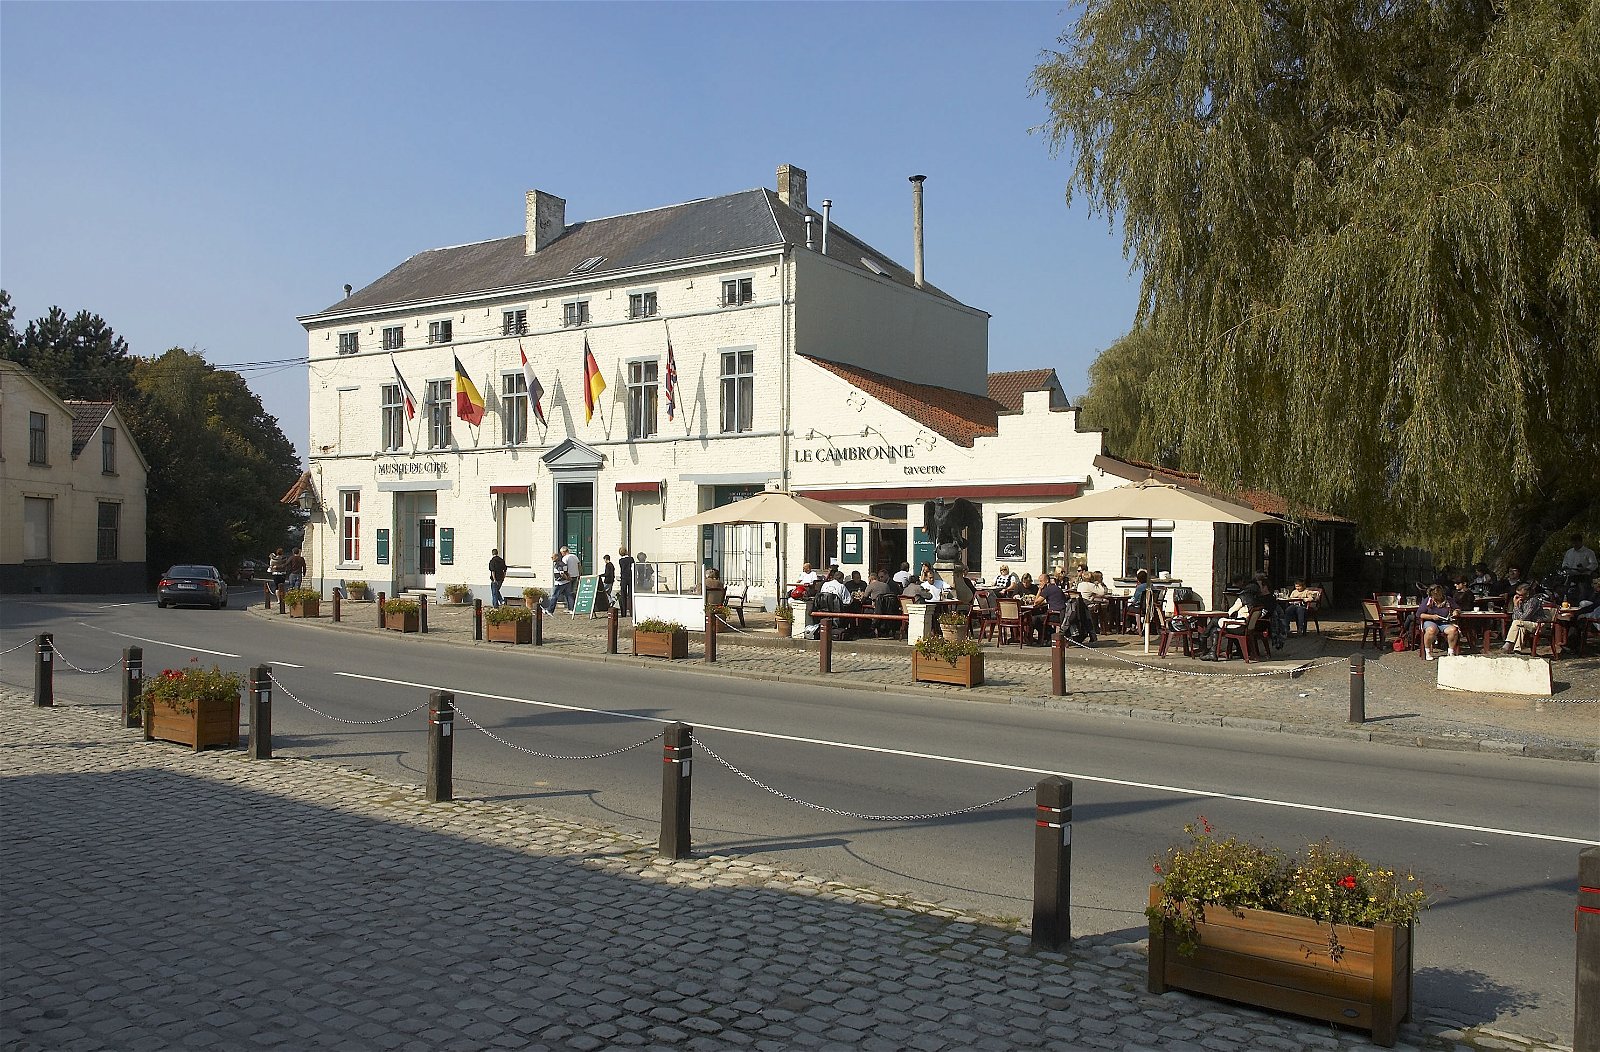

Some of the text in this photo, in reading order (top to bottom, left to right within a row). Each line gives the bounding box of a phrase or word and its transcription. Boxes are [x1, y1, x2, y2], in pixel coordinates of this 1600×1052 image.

[795, 444, 915, 463] LE CAMBRONNE
[903, 464, 946, 476] taverne
